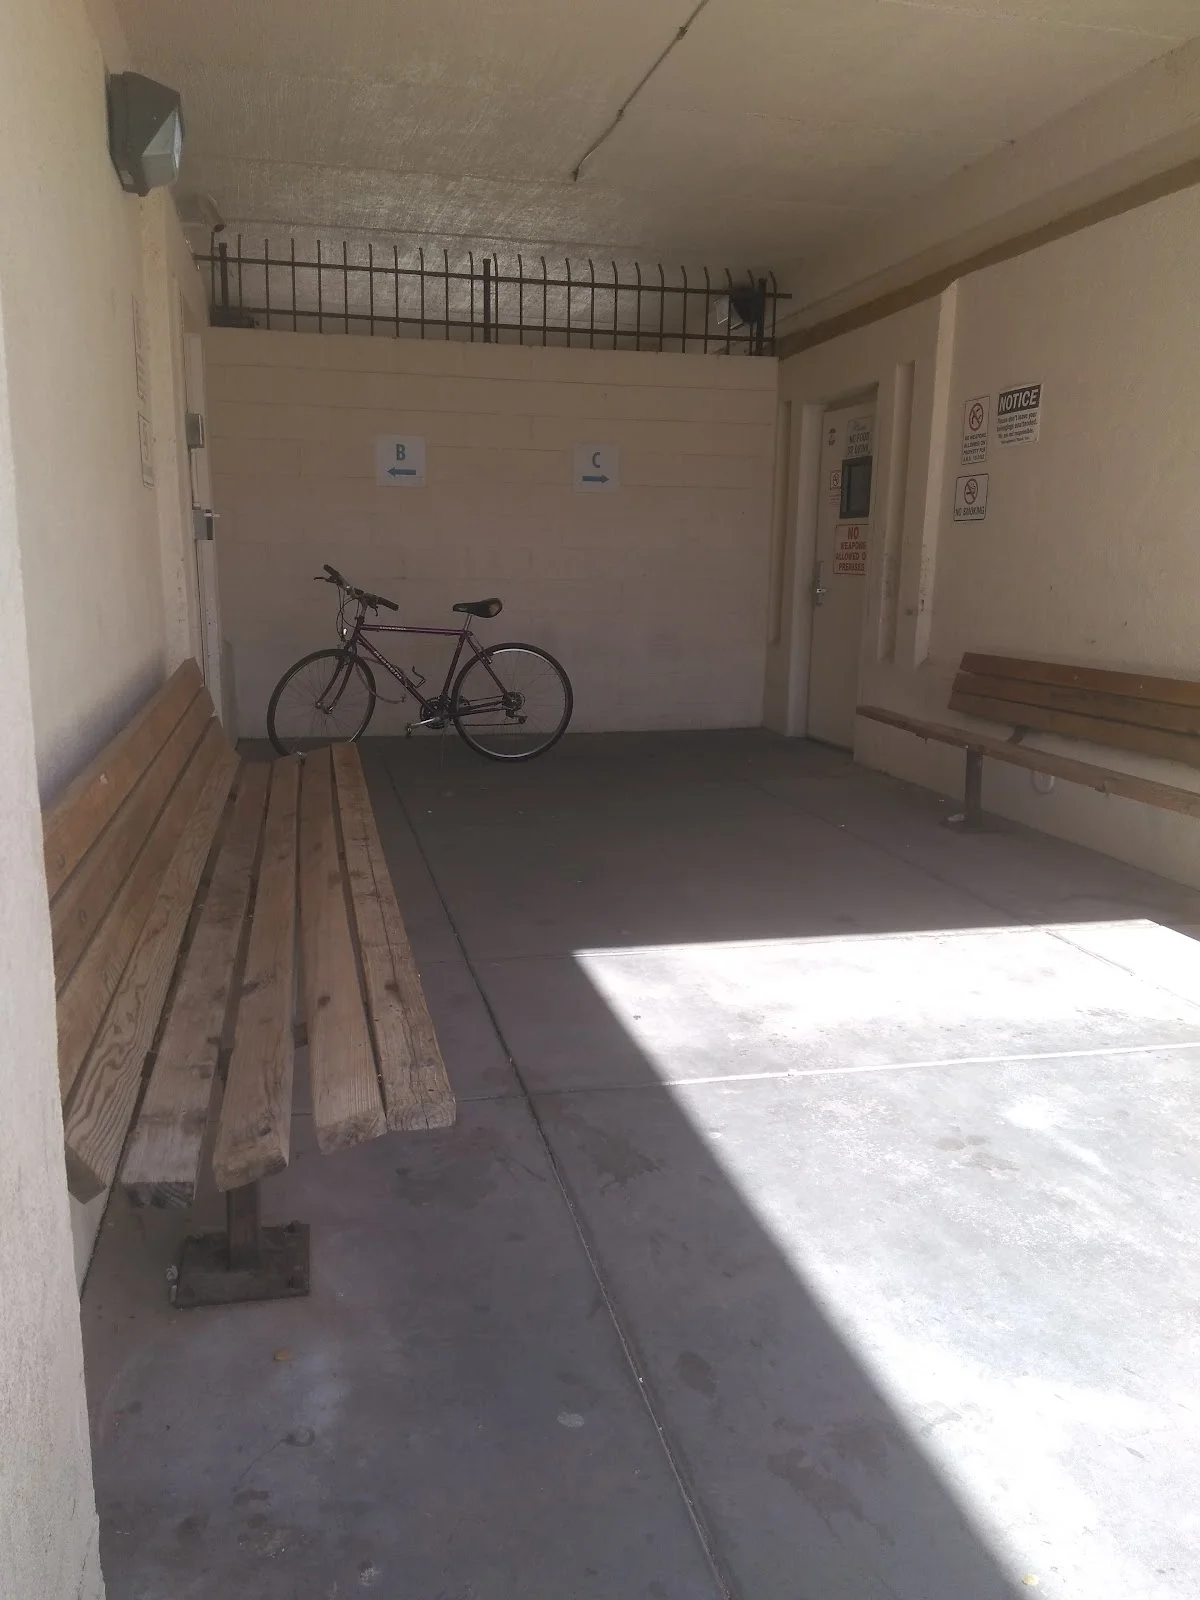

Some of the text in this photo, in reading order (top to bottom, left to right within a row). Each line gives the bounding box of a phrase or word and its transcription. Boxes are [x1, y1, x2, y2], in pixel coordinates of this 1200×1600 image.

[999, 389, 1038, 412] NOTICE
[396, 443, 406, 461] B
[592, 451, 601, 469] C
[963, 505, 985, 516] SMOKING
[847, 526, 860, 540] NO
[836, 551, 860, 561] ALLOWED
[838, 562, 865, 572] PREMISES
